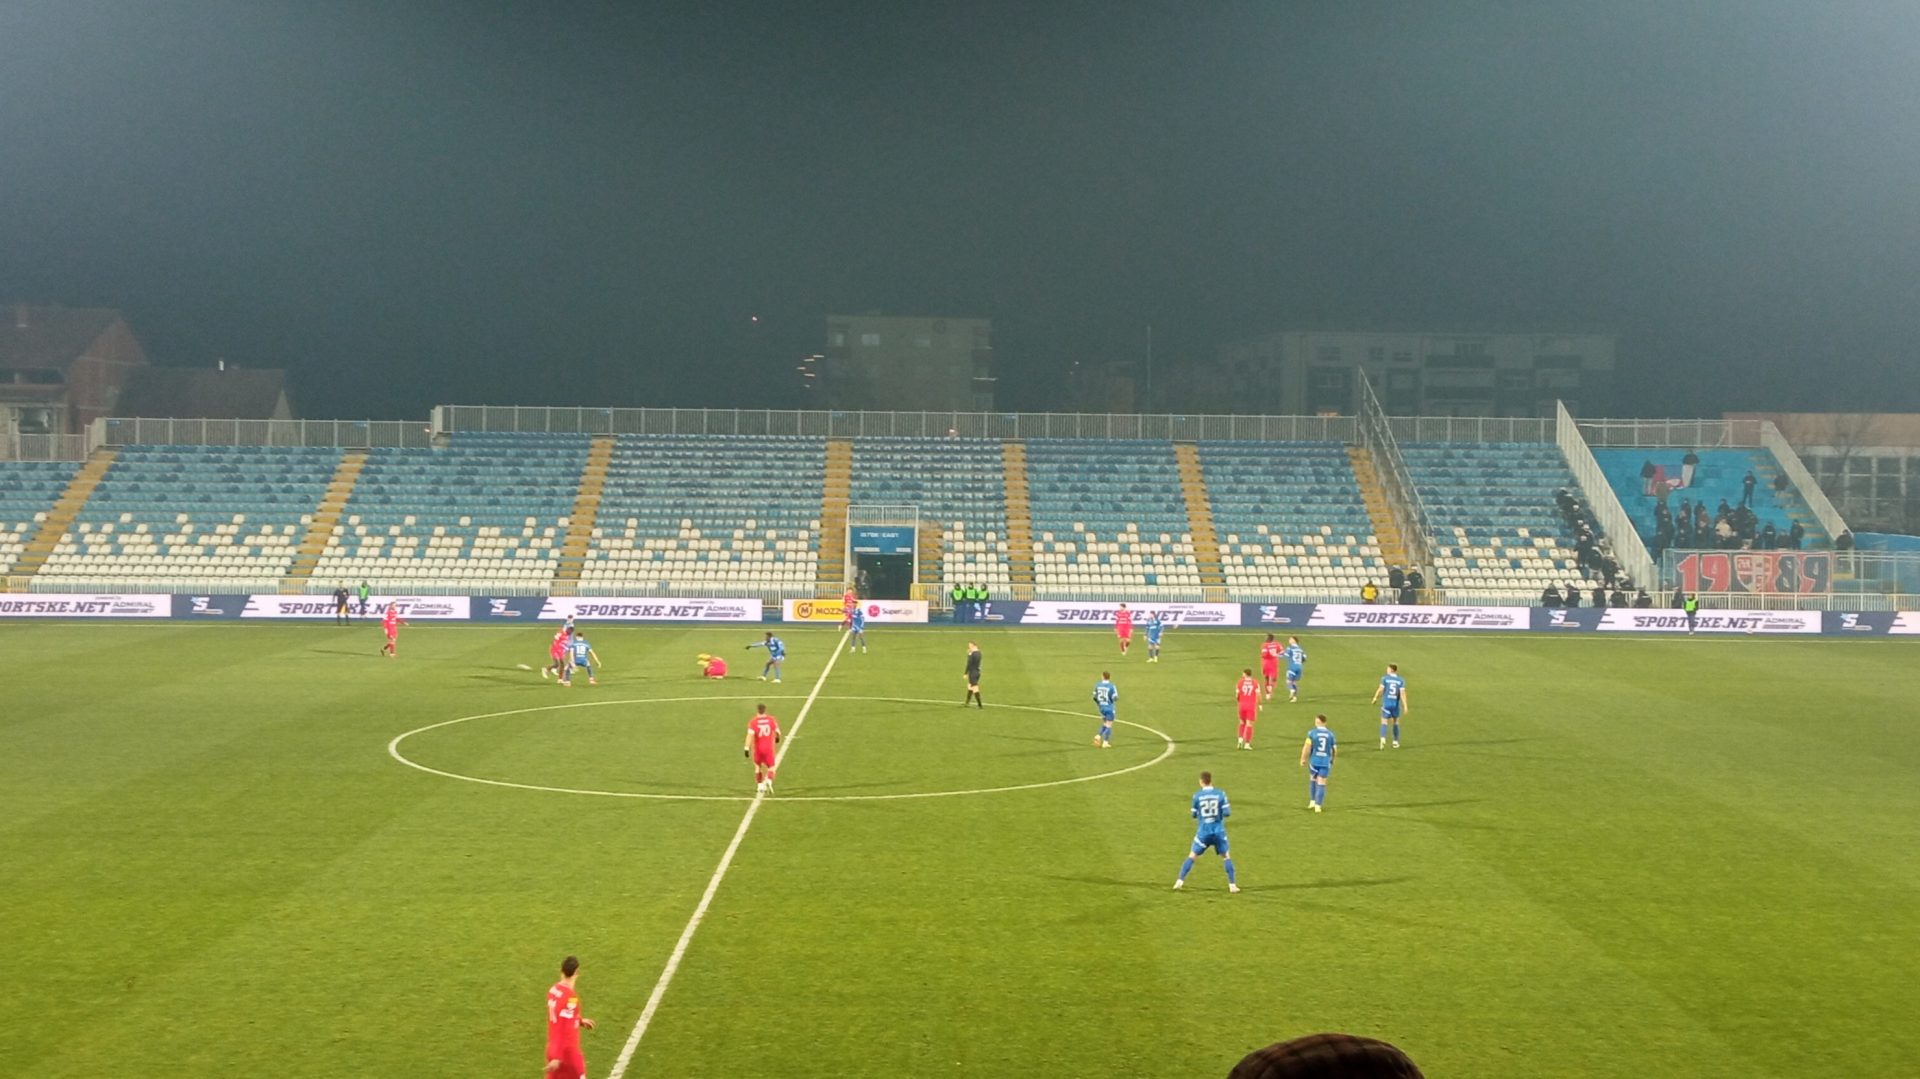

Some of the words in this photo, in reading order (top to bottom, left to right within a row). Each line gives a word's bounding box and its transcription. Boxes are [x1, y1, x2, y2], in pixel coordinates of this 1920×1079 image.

[0, 601, 111, 613] ORTSKE.NET
[575, 604, 704, 617] SPORTSKE.NET
[1344, 612, 1472, 625] SPORTSKE.NET
[1241, 684, 1254, 696] 97
[1389, 683, 1397, 695] 5
[758, 724, 770, 738] 70
[1317, 737, 1327, 752] 3
